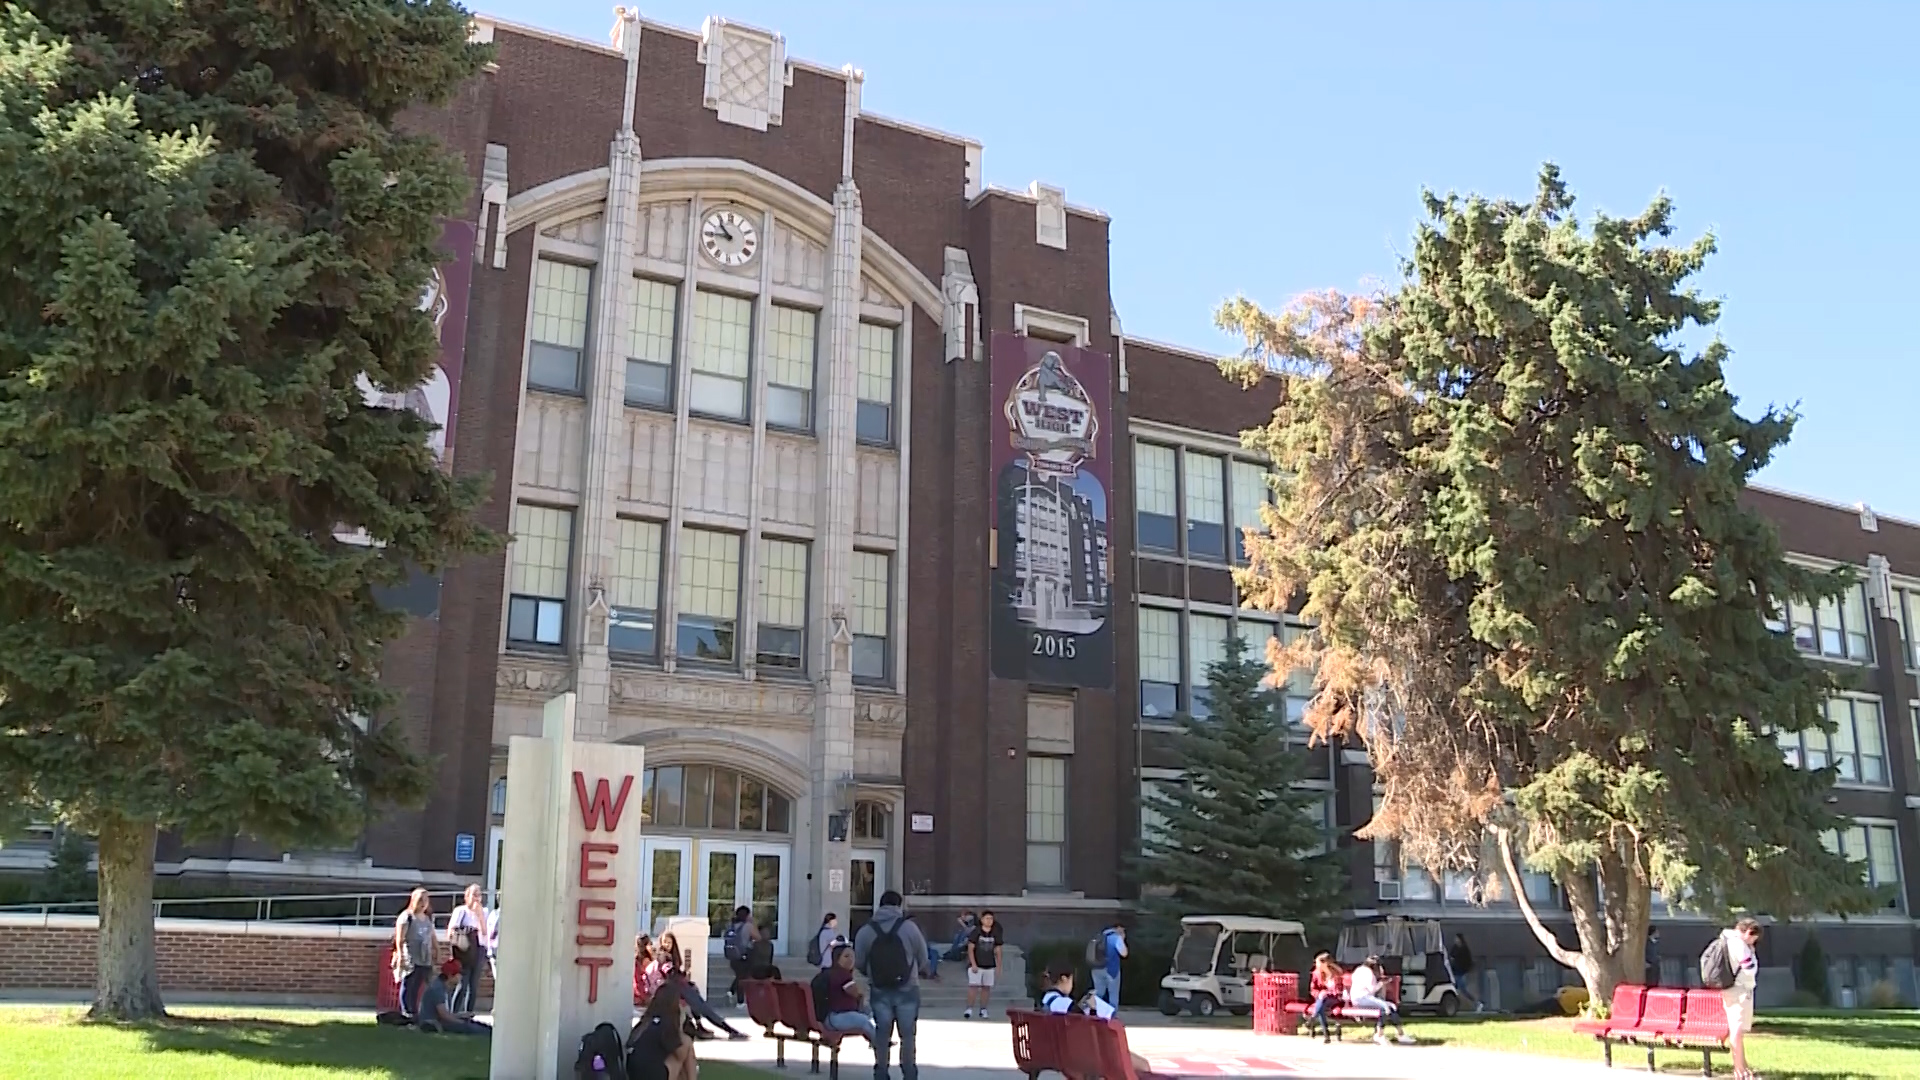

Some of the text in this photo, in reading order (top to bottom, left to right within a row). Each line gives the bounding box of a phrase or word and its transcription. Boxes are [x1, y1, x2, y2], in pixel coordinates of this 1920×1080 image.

[1022, 400, 1084, 424] WEST
[1035, 418, 1071, 434] HIGH
[1032, 632, 1077, 659] 2015
[573, 770, 635, 1005] WEST
